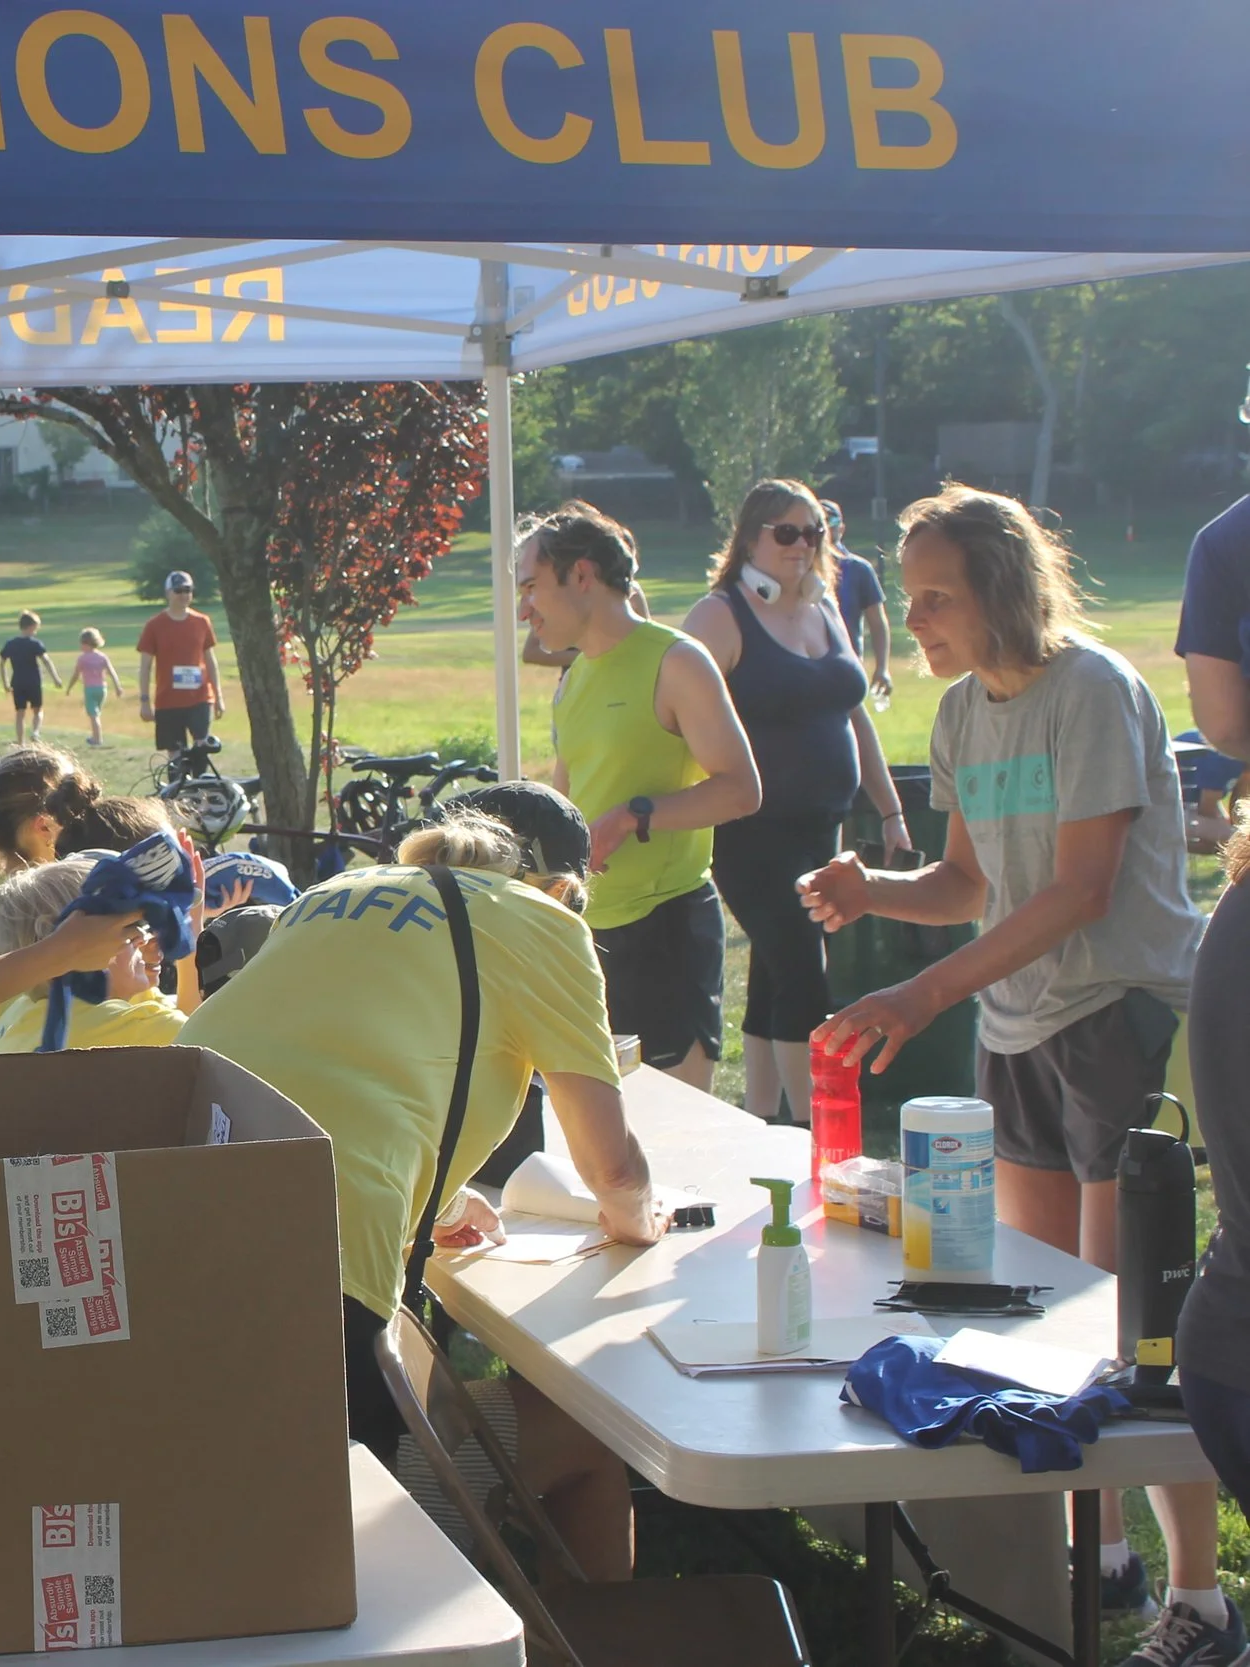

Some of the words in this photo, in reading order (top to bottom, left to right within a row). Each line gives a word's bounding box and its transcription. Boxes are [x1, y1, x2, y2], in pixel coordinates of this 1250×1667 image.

[473, 22, 959, 170] CLUB
[236, 862, 273, 880] 2025
[284, 885, 448, 933] TAFF
[933, 1138, 960, 1150] CLOROX
[67, 1250, 81, 1281] Simple
[74, 1238, 90, 1278] Absurdly
[1161, 1267, 1190, 1282] pwc
[94, 1299, 107, 1329] Simple
[46, 1582, 58, 1621] Absurdly
[54, 1580, 65, 1611] Simple
